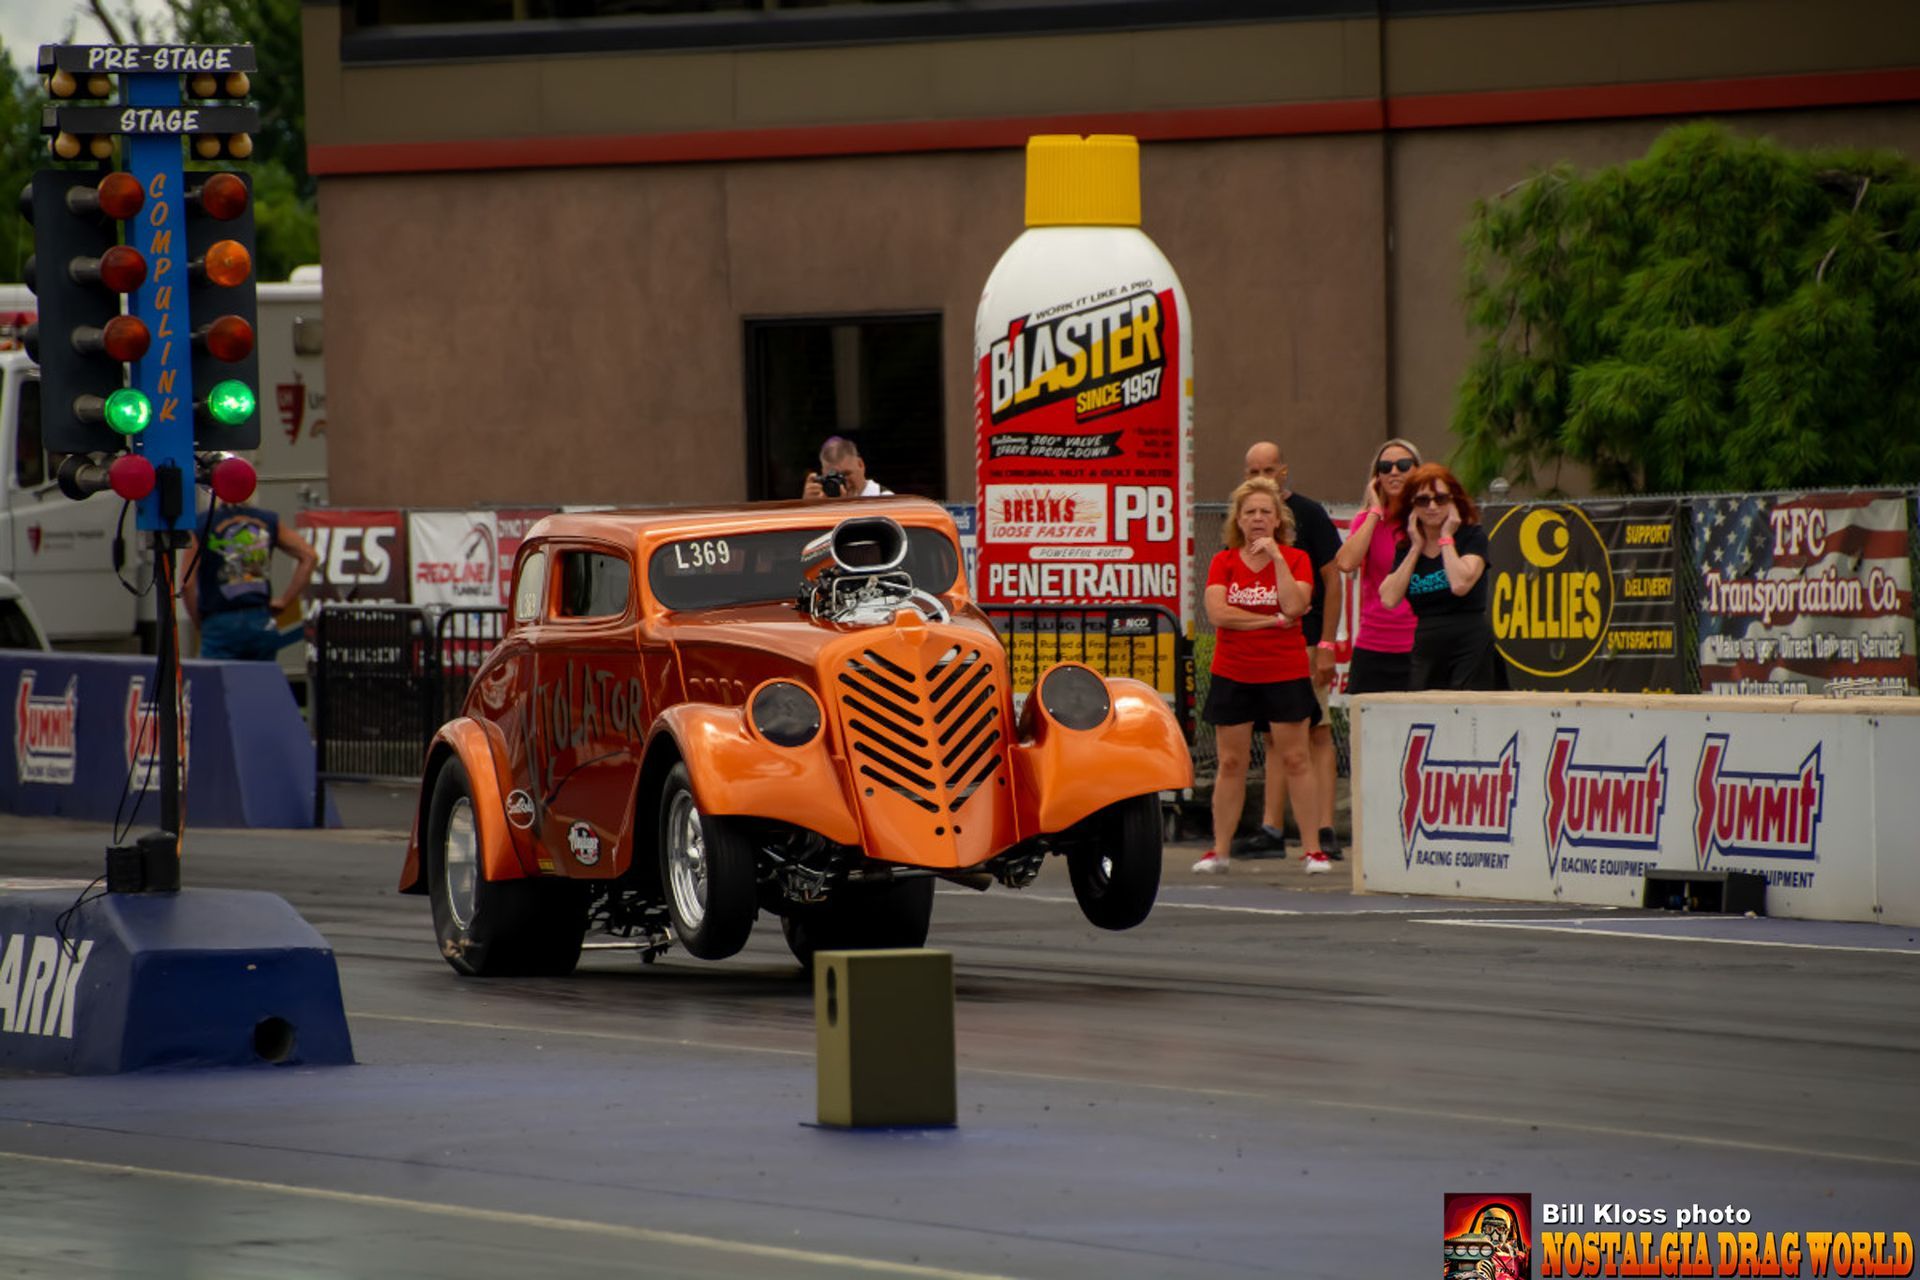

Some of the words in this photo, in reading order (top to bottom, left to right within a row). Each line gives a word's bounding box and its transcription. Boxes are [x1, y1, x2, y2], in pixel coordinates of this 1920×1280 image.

[88, 47, 232, 70] PRE-STAGE
[120, 110, 200, 132] STAGE
[149, 173, 178, 422] COMPULINK
[1035, 303, 1073, 320] WORK
[1076, 296, 1088, 307] IT
[1090, 287, 1118, 302] LIKE
[1120, 285, 1129, 294] A
[1076, 381, 1122, 414] SINCE
[1121, 367, 1162, 407] 1957
[1065, 435, 1103, 447] VALVE
[1002, 498, 1077, 524] BREAKS
[1114, 485, 1174, 543] PB
[992, 525, 1036, 538] LOOSE
[1039, 525, 1097, 538] FASTER
[1625, 523, 1671, 545] SUPPORT
[1771, 508, 1826, 556] TFC
[675, 540, 731, 569] L369
[416, 562, 486, 584] REDLINE
[989, 563, 1178, 598] PENETRATING
[1624, 576, 1672, 598] DELIVERY
[1706, 570, 1862, 624] Transportation
[1868, 577, 1901, 611] Co.
[1492, 571, 1600, 641] CALLIES
[1607, 630, 1672, 651] SATISFACTION
[1781, 635, 1813, 659] Direct
[1415, 849, 1453, 867] RACING
[1455, 852, 1510, 870] EQUIPMENT
[1560, 857, 1597, 874] RACING
